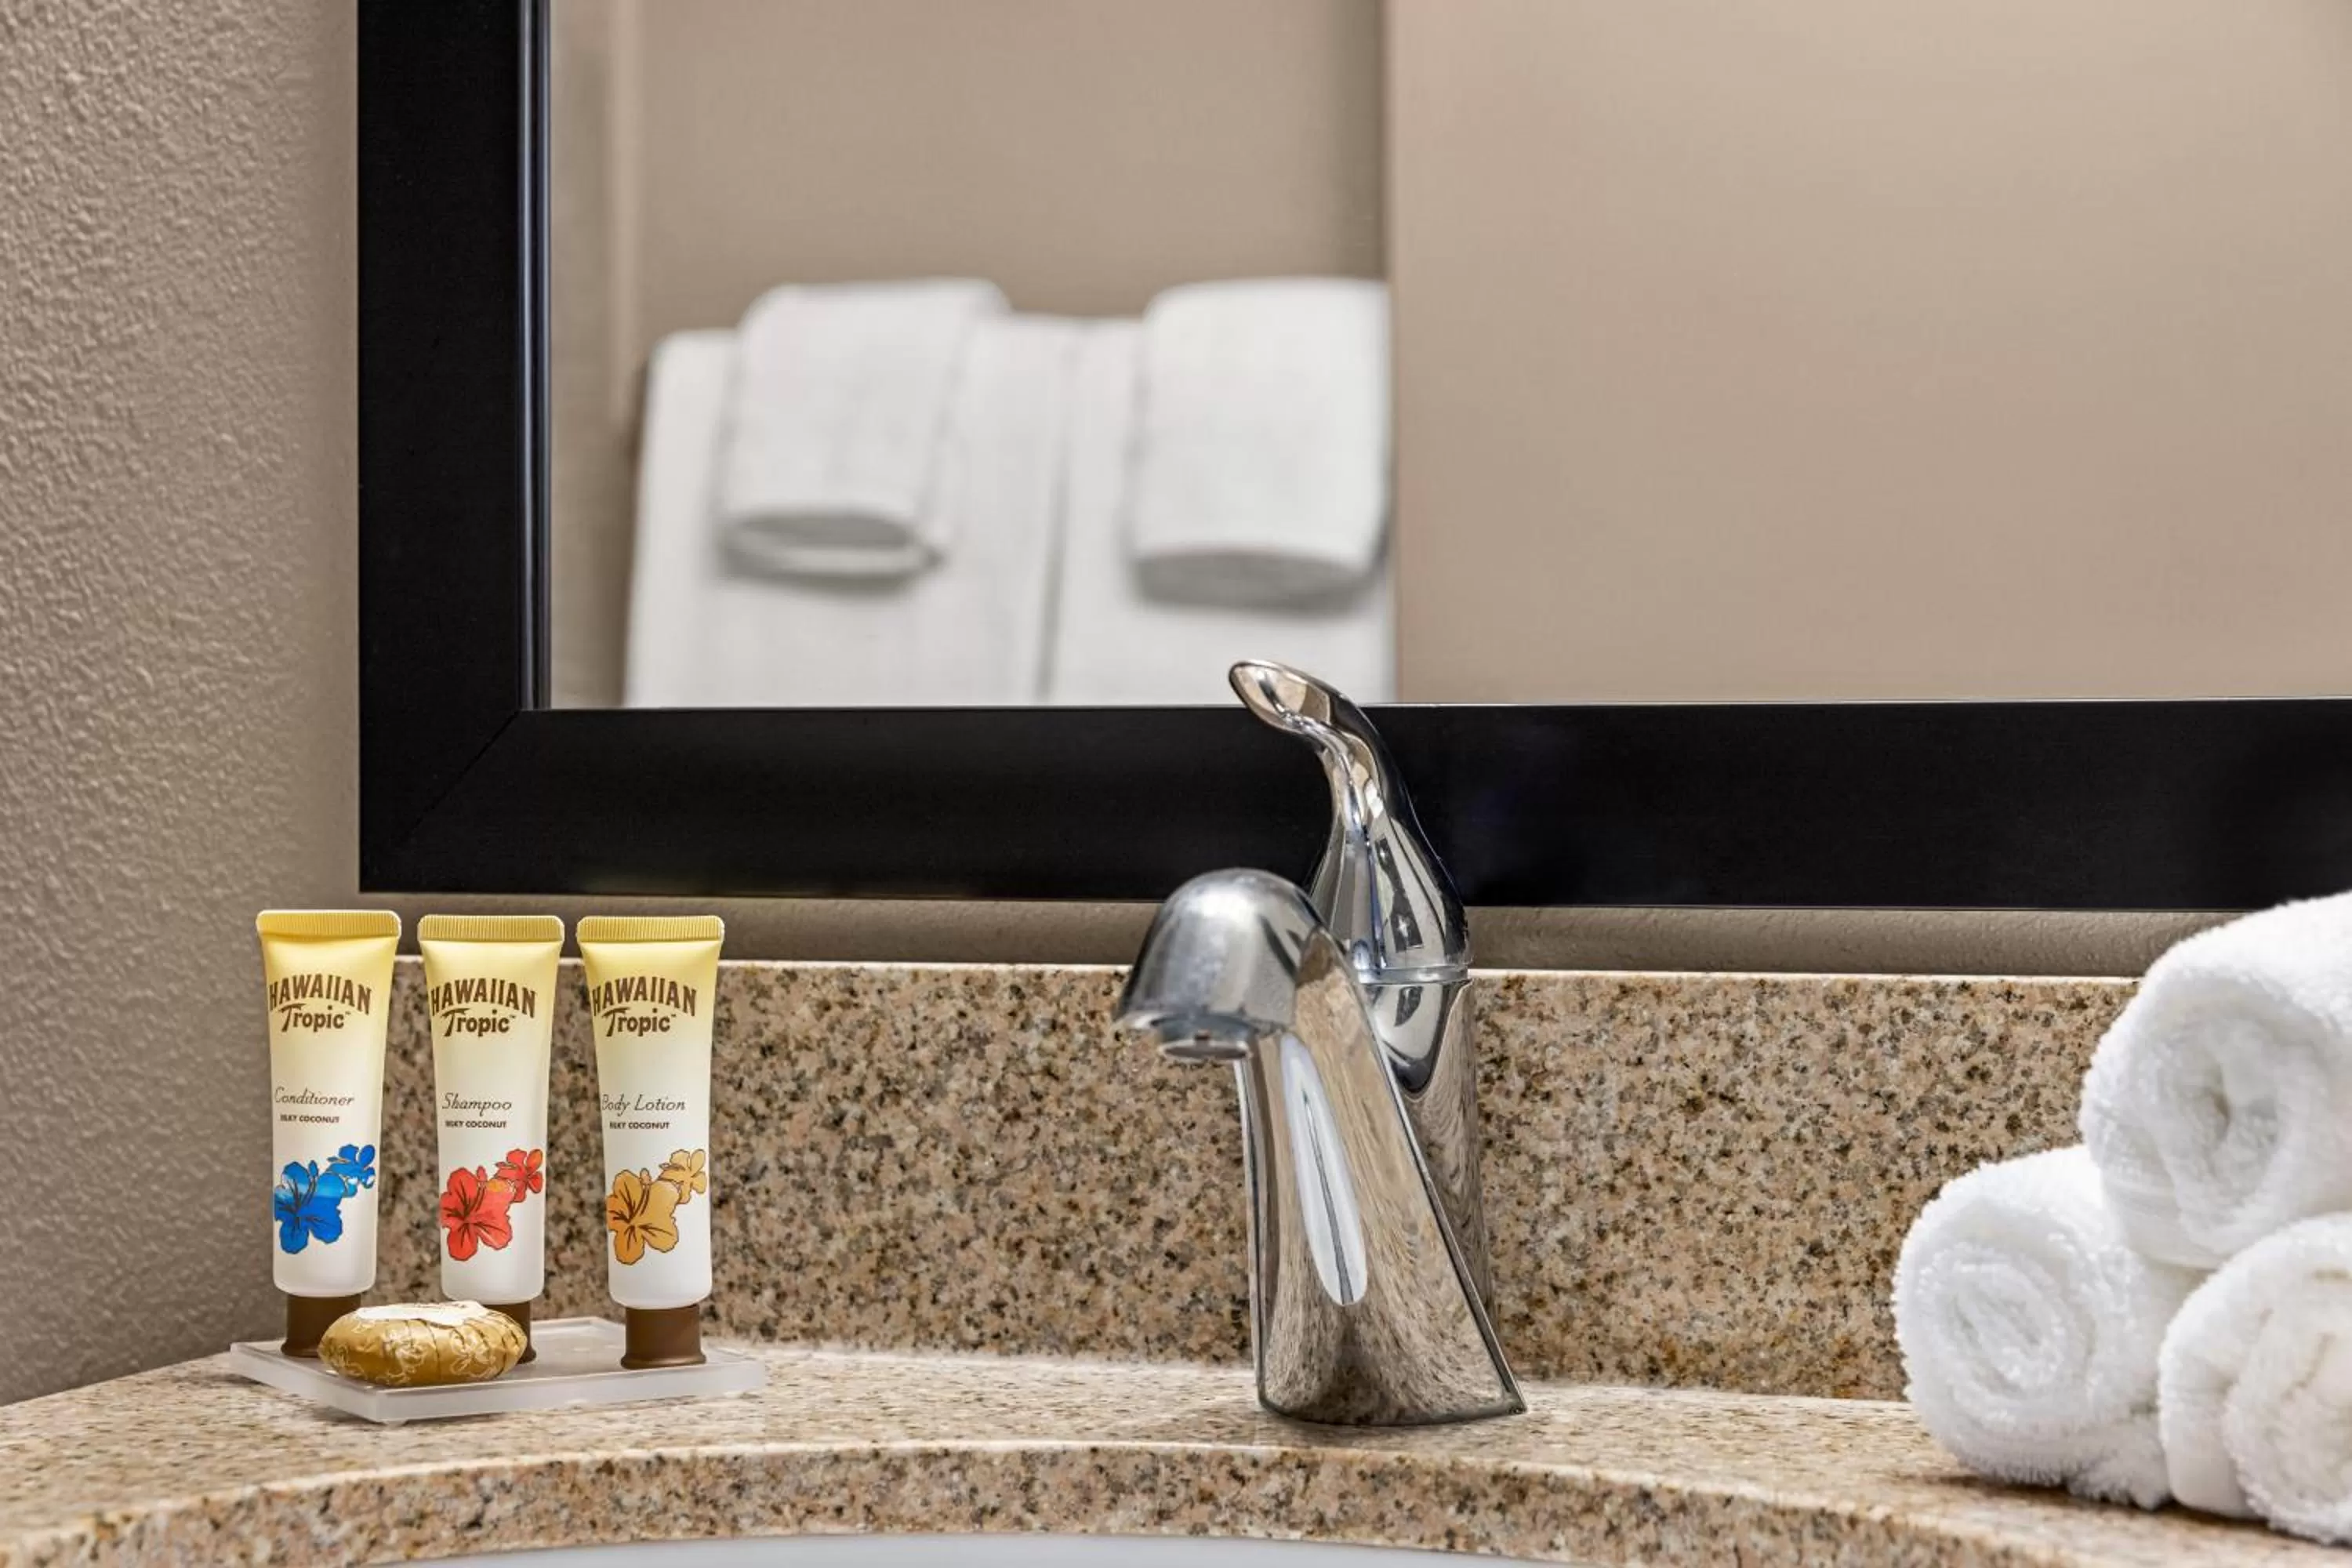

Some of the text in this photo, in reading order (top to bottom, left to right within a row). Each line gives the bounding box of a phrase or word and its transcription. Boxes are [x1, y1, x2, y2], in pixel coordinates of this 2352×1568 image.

[269, 973, 372, 1016] HAWAIIAN
[430, 978, 536, 1018] HAWAIIAN
[592, 976, 696, 1017] HAWAIIAN
[278, 1003, 345, 1033] Tropic
[441, 1007, 510, 1037] Tropic
[602, 1007, 670, 1036] Tropic
[275, 1085, 355, 1106] Conditioner
[441, 1092, 512, 1117] Shampoo
[633, 1094, 686, 1111] Lotion
[299, 1114, 340, 1123] COCONUT
[466, 1120, 507, 1128] COCONUT
[628, 1121, 671, 1130] COCONUT
